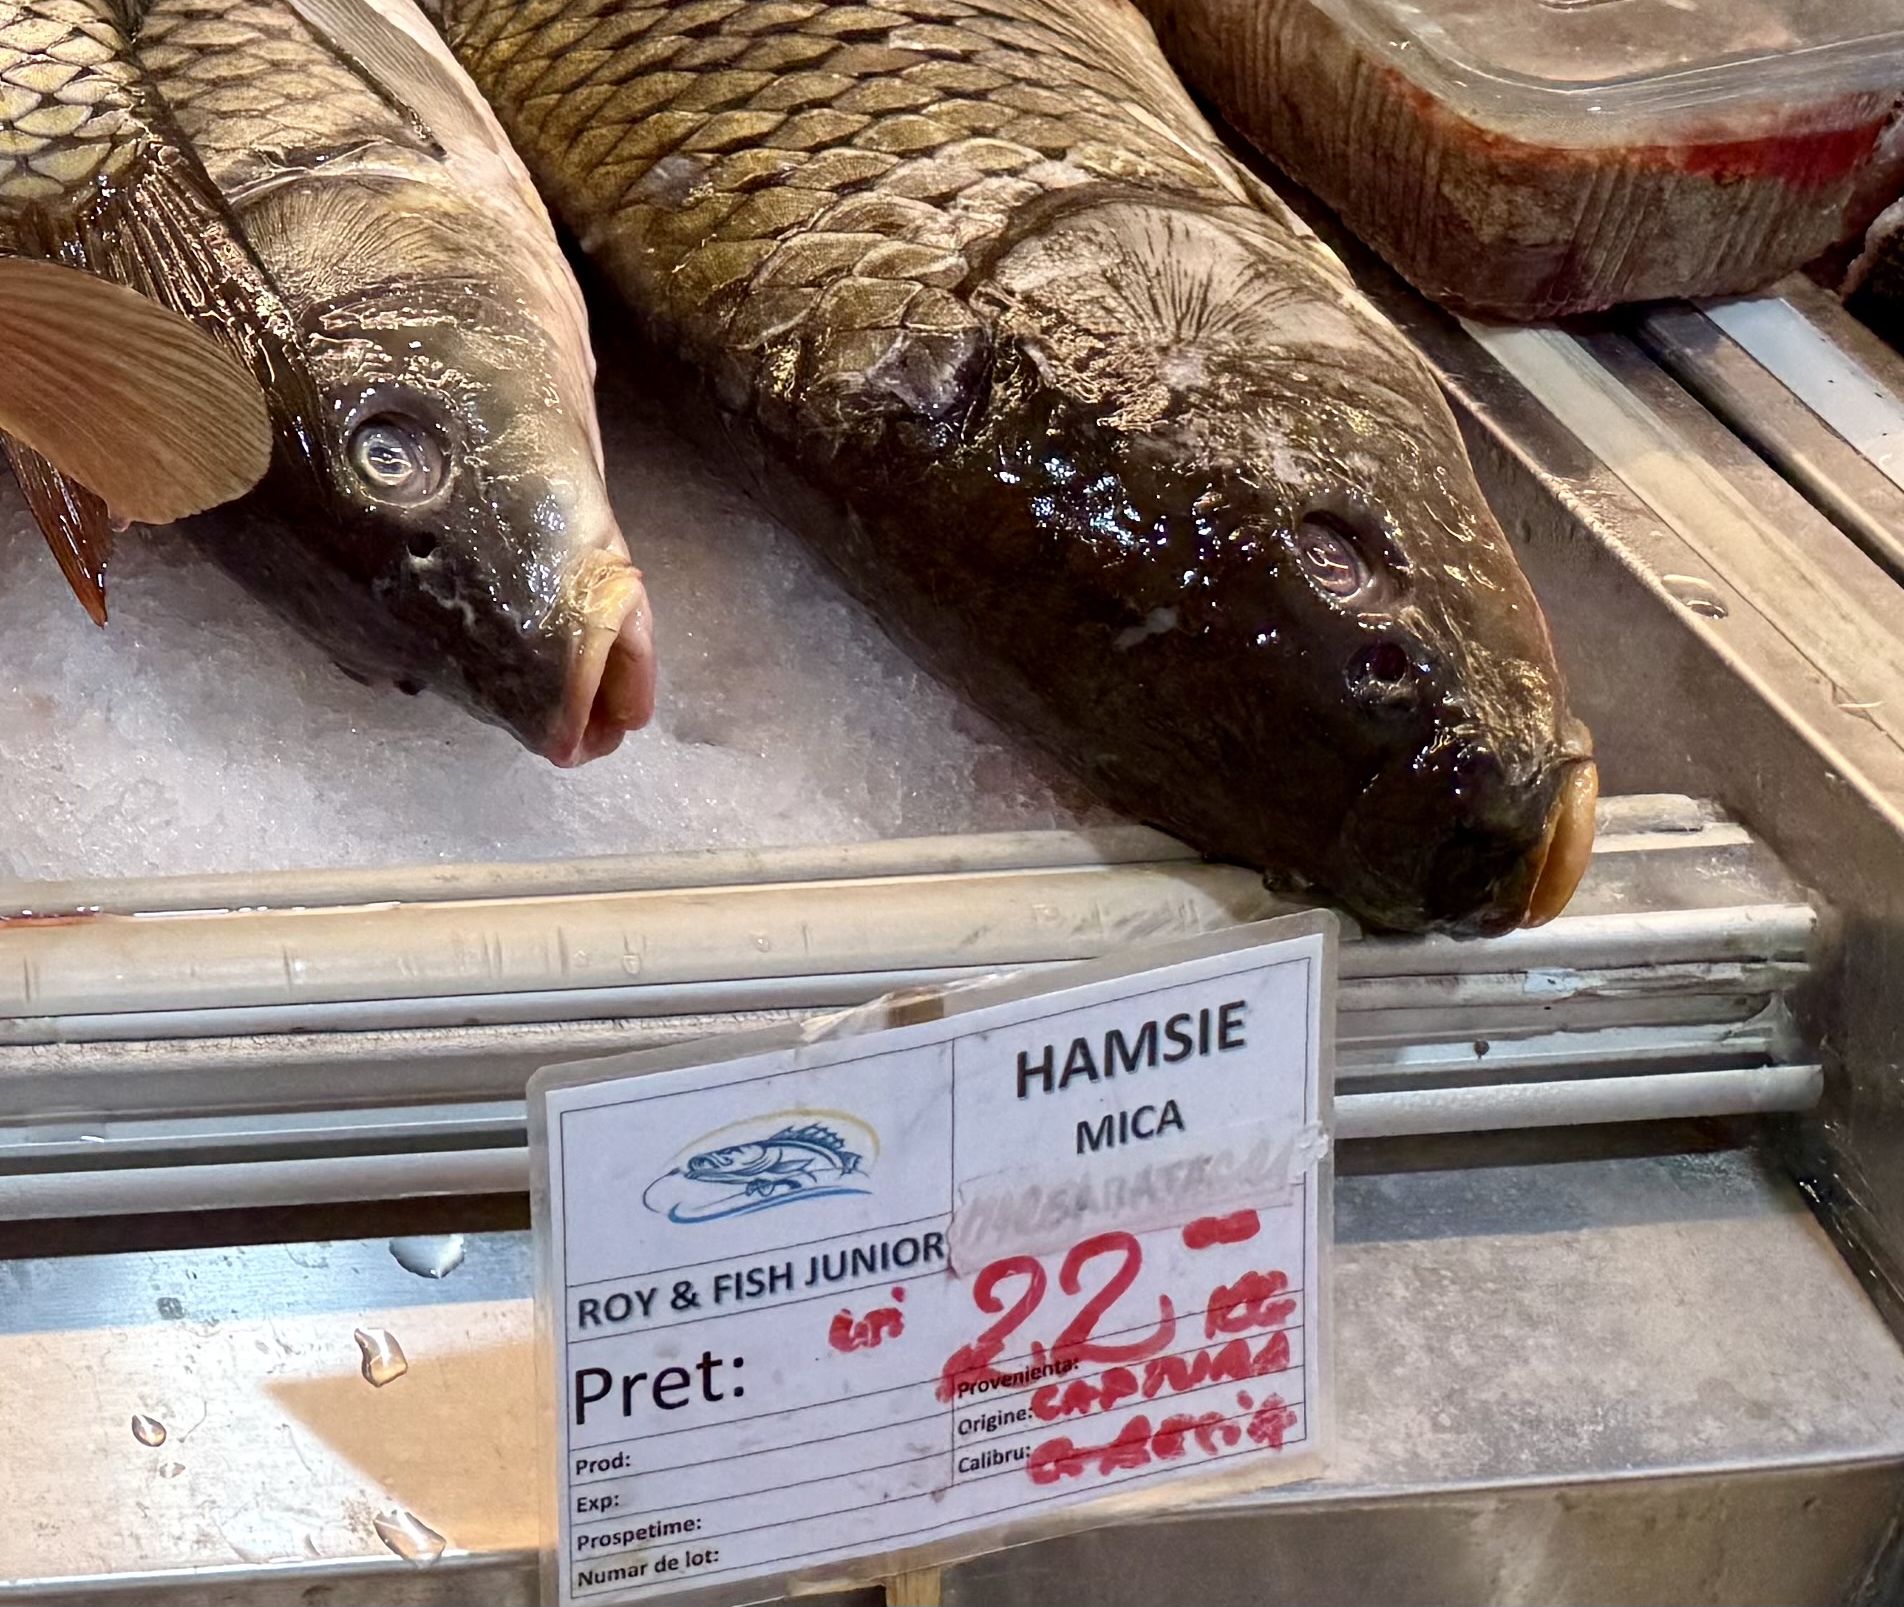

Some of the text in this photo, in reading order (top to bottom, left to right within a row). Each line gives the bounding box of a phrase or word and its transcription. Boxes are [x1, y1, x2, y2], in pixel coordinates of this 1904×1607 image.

[1016, 999, 1246, 1099] HAMSIE
[1077, 1099, 1185, 1155] MICA
[578, 1231, 946, 1330] ROY & FISH JUNIOR
[575, 1230, 1176, 1425] Pret: 22
[957, 1358, 1080, 1399] Provenienta:
[958, 1406, 1033, 1437] Origine:
[576, 1452, 631, 1476] Prod:
[958, 1445, 1030, 1474] Calibru:
[577, 1493, 620, 1514] Exp:
[577, 1515, 702, 1552] Prospetime:
[577, 1546, 720, 1588] Numar de lot:
